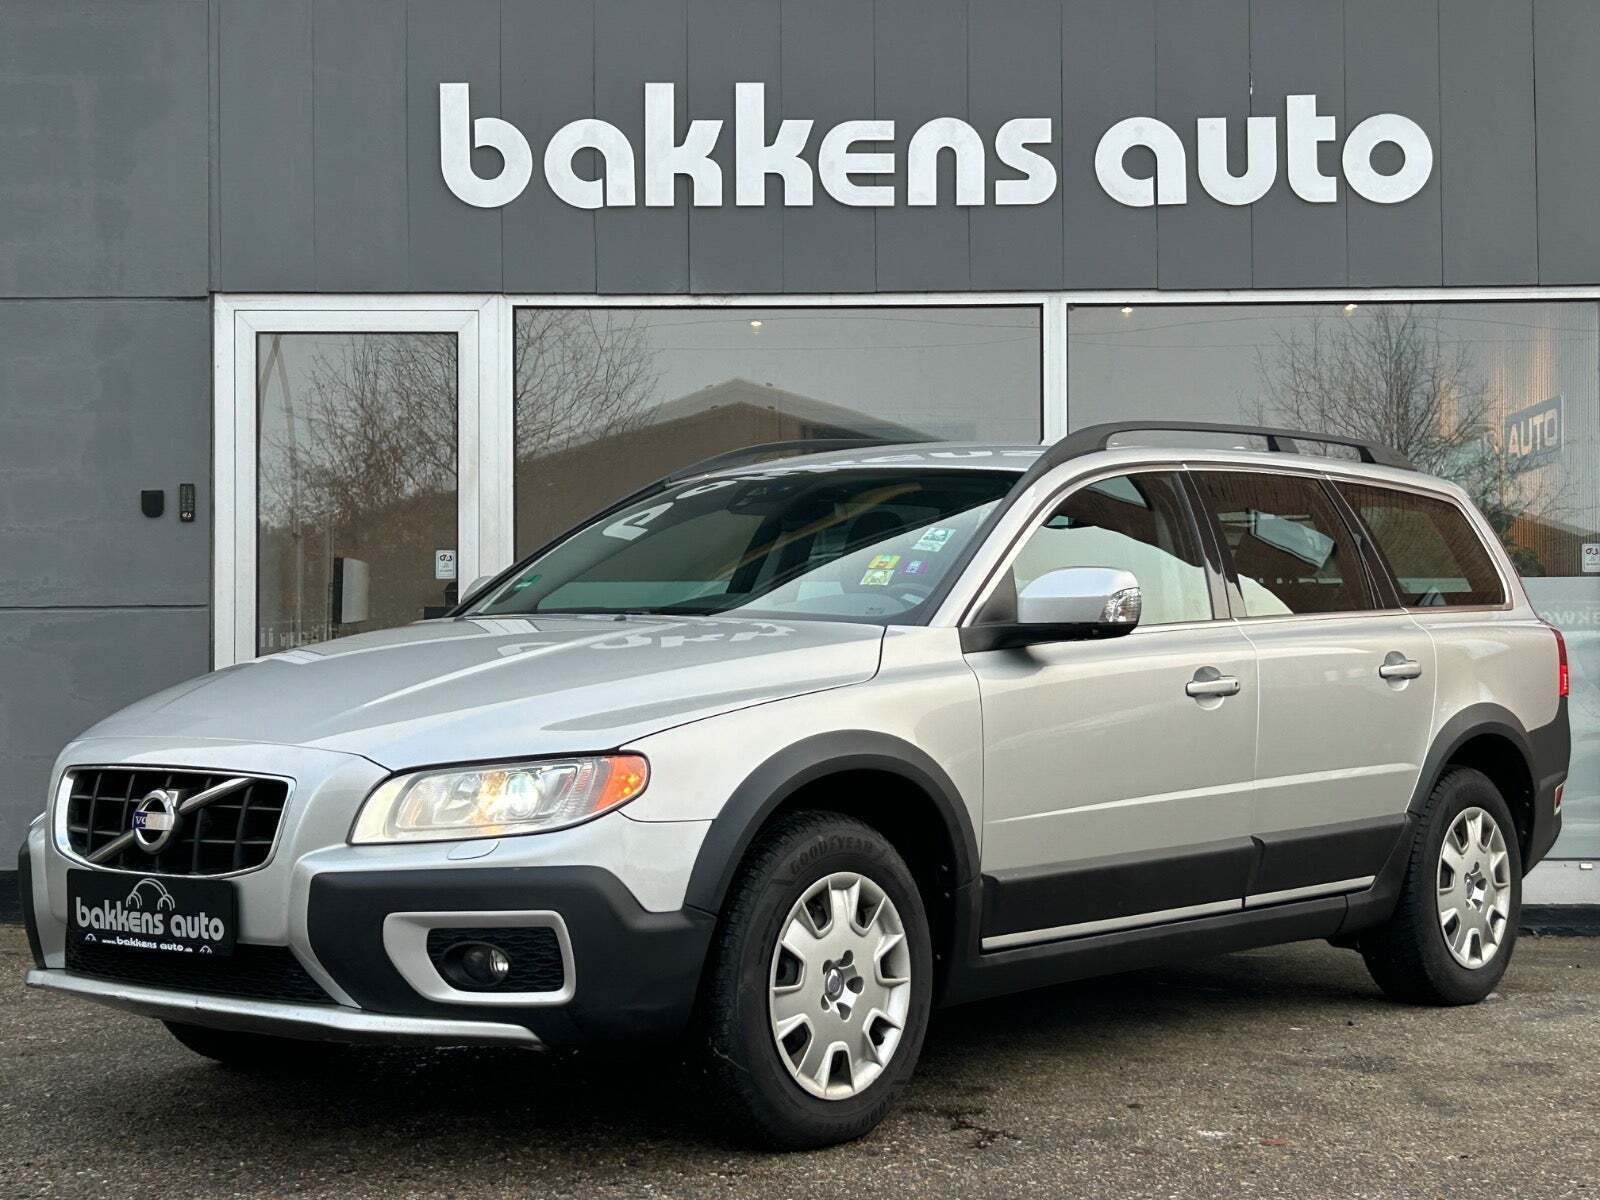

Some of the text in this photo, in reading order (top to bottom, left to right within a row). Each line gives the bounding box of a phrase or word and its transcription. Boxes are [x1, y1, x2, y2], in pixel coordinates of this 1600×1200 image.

[439, 82, 1434, 209] bakkens auto
[1508, 408, 1558, 459] AUTO
[75, 896, 225, 941] bakkens auto
